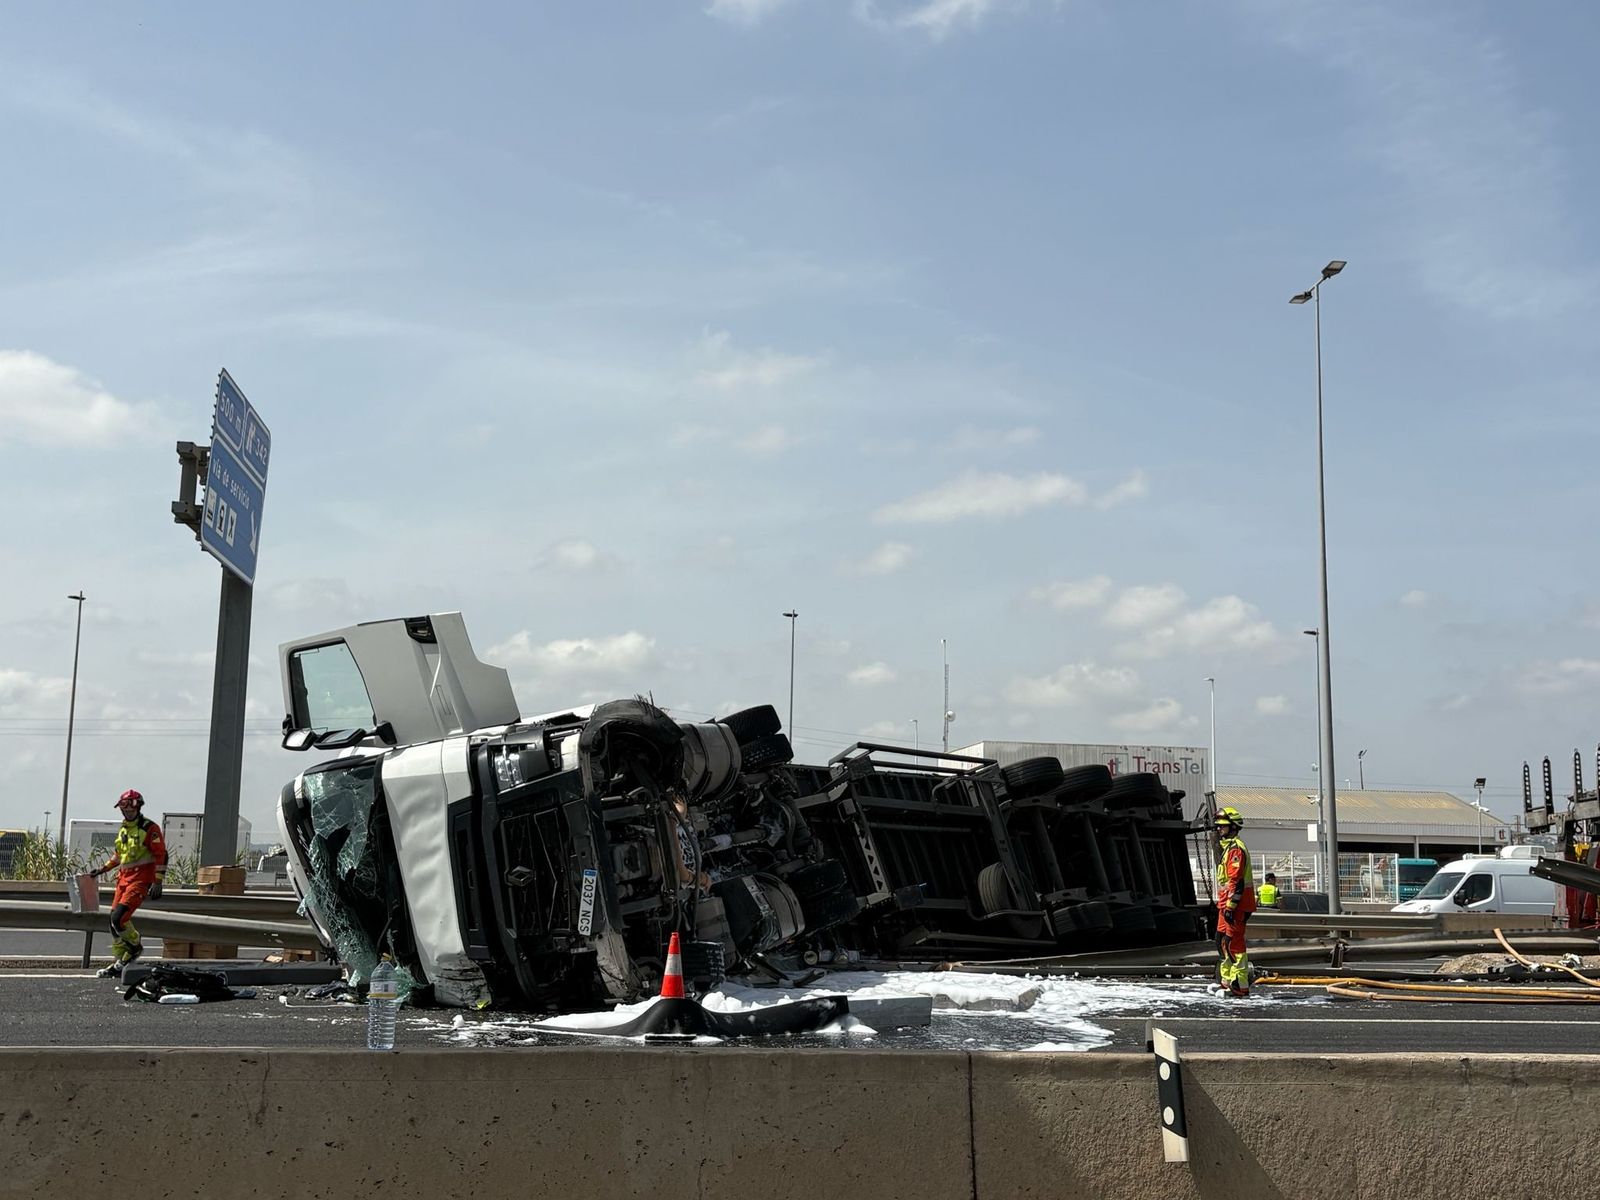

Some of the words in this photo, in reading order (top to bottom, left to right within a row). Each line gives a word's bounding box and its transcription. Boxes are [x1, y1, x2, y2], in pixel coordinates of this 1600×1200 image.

[220, 391, 234, 422] 500
[235, 415, 242, 434] m
[255, 438, 267, 466] 342
[223, 468, 229, 488] de
[230, 479, 250, 510] servicio
[1132, 756, 1204, 774] TransTel
[583, 877, 594, 906] 2037
[580, 910, 591, 932] NCS
